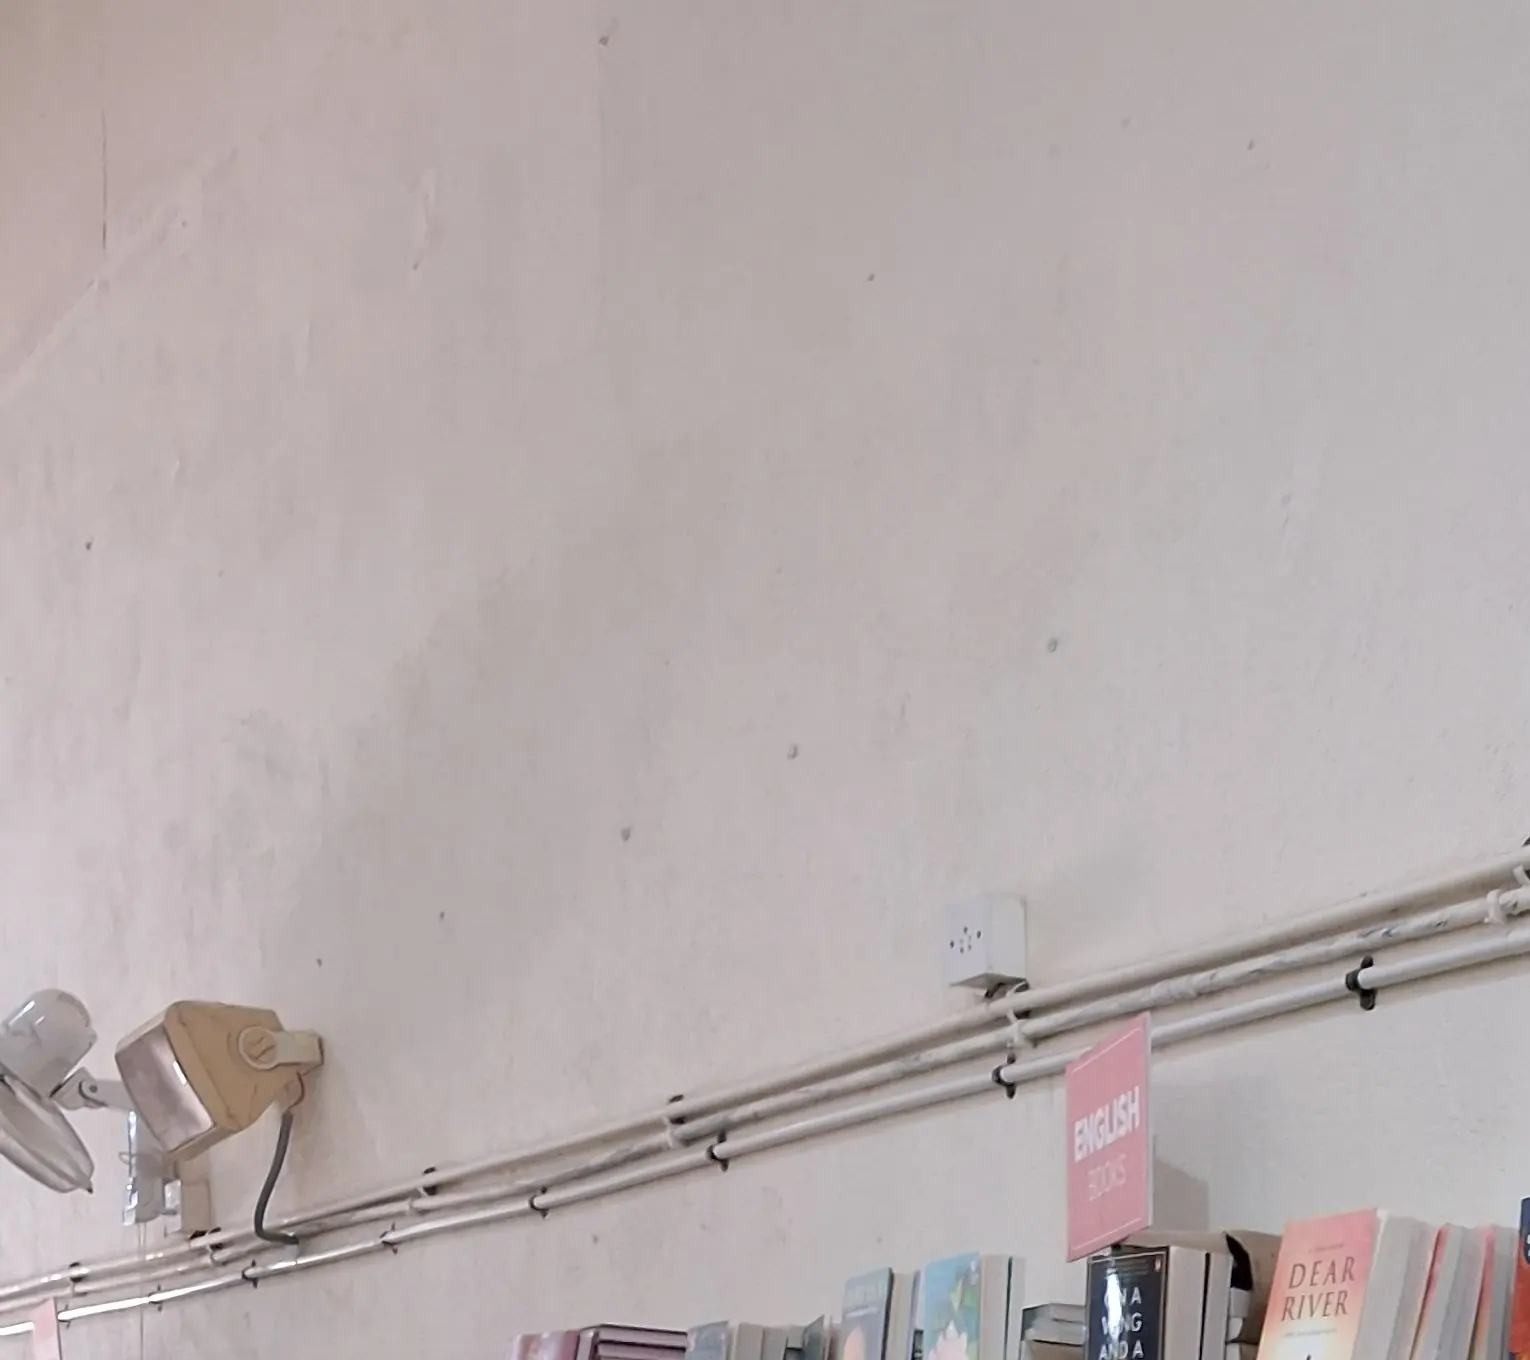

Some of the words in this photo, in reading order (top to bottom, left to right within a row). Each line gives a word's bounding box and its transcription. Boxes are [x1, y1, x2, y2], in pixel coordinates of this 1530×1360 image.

[1074, 1085, 1139, 1163] ENGLISH
[1088, 1154, 1126, 1201] BOOKS
[1288, 1256, 1356, 1291] DEAR
[1281, 1290, 1349, 1322] RIVER
[1132, 1339, 1144, 1359] A
